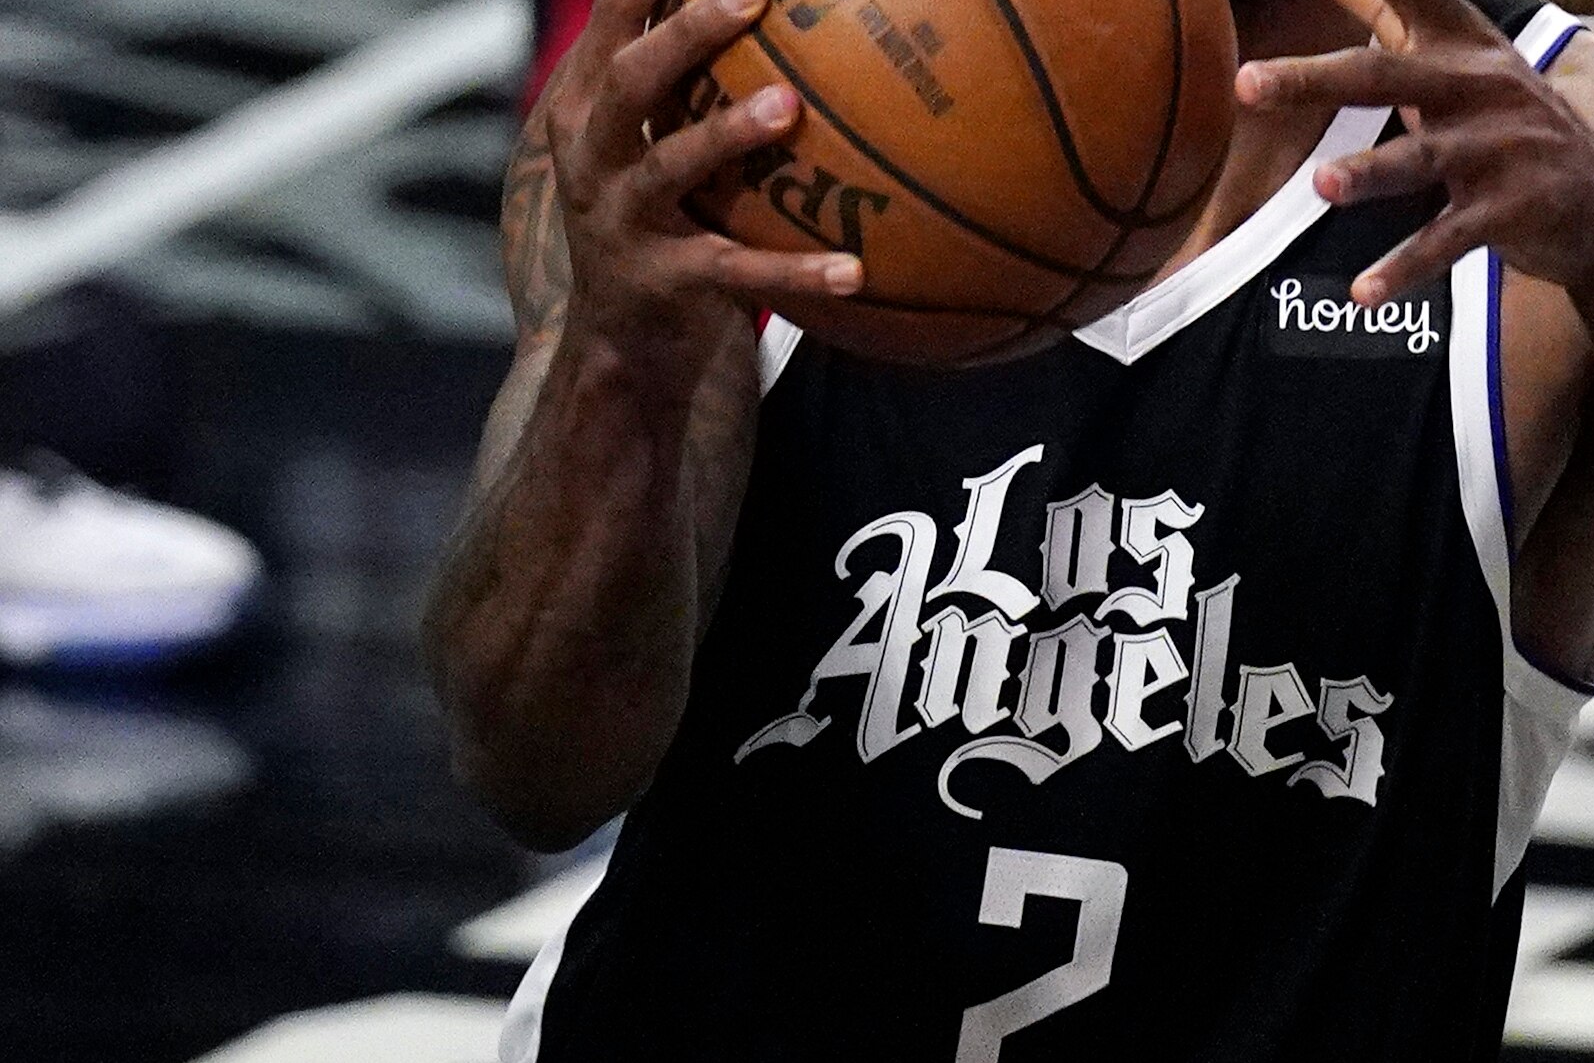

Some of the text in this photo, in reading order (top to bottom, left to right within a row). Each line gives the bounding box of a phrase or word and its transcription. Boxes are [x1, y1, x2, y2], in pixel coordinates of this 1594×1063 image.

[1270, 278, 1440, 354] honey
[926, 443, 1206, 622] Los
[733, 510, 1395, 820] Angeles
[954, 846, 1129, 1063] 2
